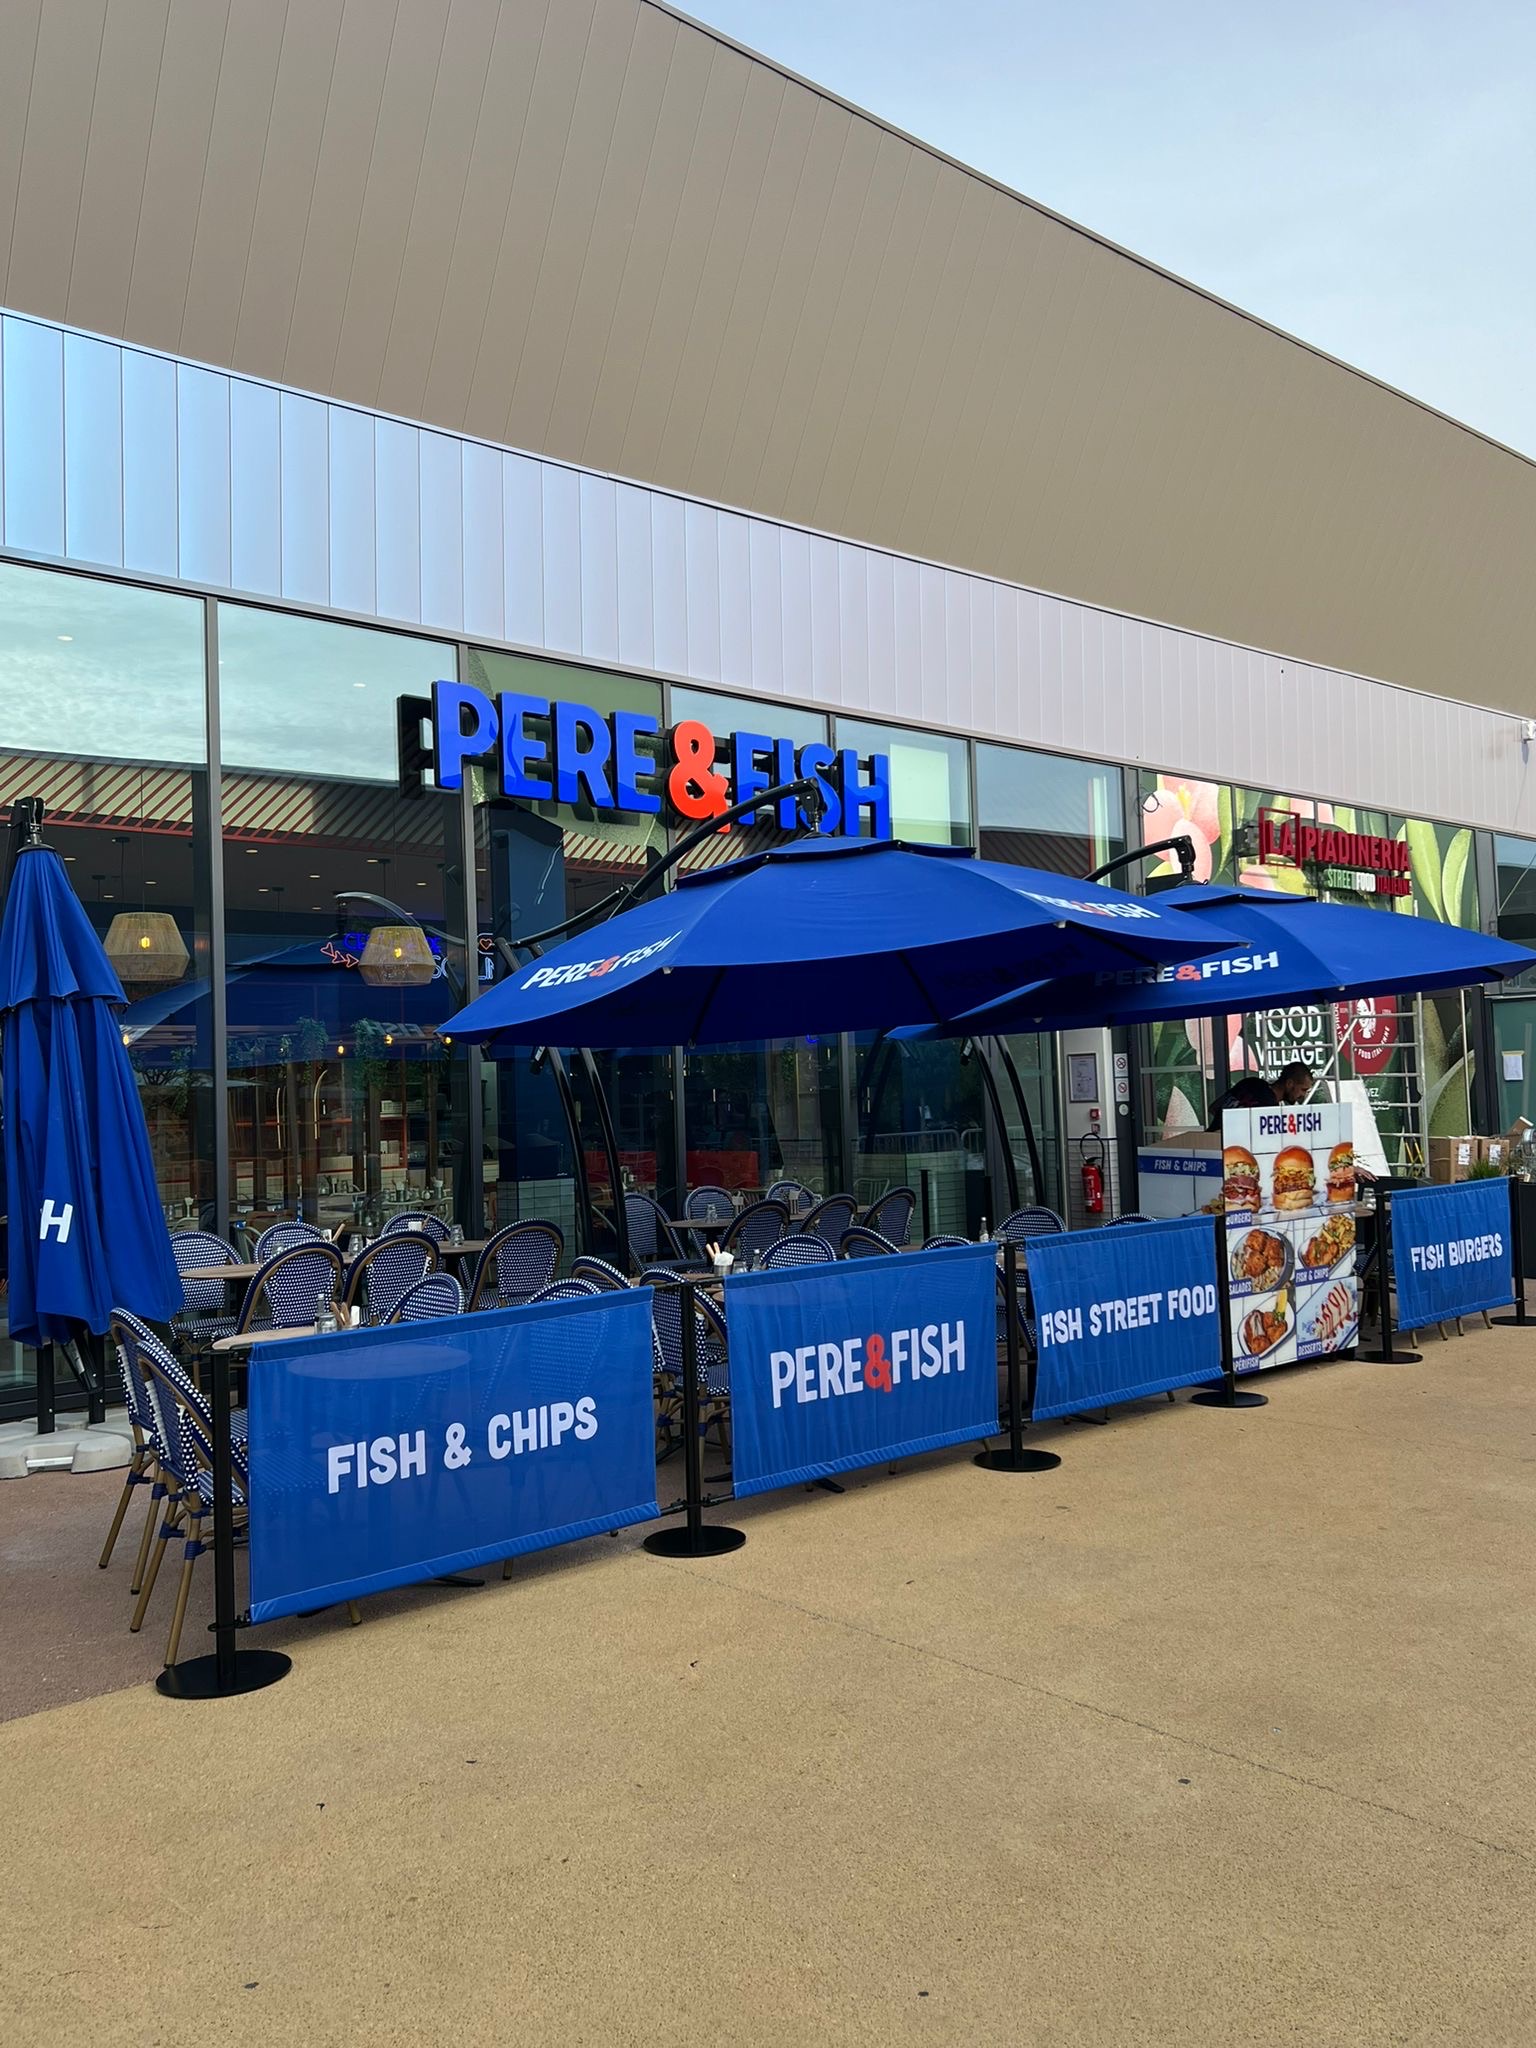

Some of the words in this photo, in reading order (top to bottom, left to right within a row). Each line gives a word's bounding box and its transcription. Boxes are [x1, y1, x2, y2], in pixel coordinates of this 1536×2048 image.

[435, 680, 890, 840] PERE&FISH
[1265, 820, 1296, 856] LA
[1301, 826, 1412, 872] PIADINERIA
[1255, 1041, 1324, 1067] VILLAGE
[1260, 1113, 1321, 1135] PERE&FISH
[1154, 1160, 1172, 1170] FISH
[1173, 1161, 1180, 1171] &
[1183, 1161, 1207, 1172] CHIPS
[1411, 1244, 1445, 1272] FISH
[1448, 1232, 1503, 1267] BURGERS
[1041, 1308, 1083, 1348] FISH
[1089, 1292, 1162, 1337] STREET
[1167, 1284, 1216, 1321] FOOD
[770, 1320, 966, 1409] PERE&FISH
[327, 1429, 426, 1494] FISH
[443, 1422, 472, 1470] &
[488, 1396, 599, 1460] CHIPS
